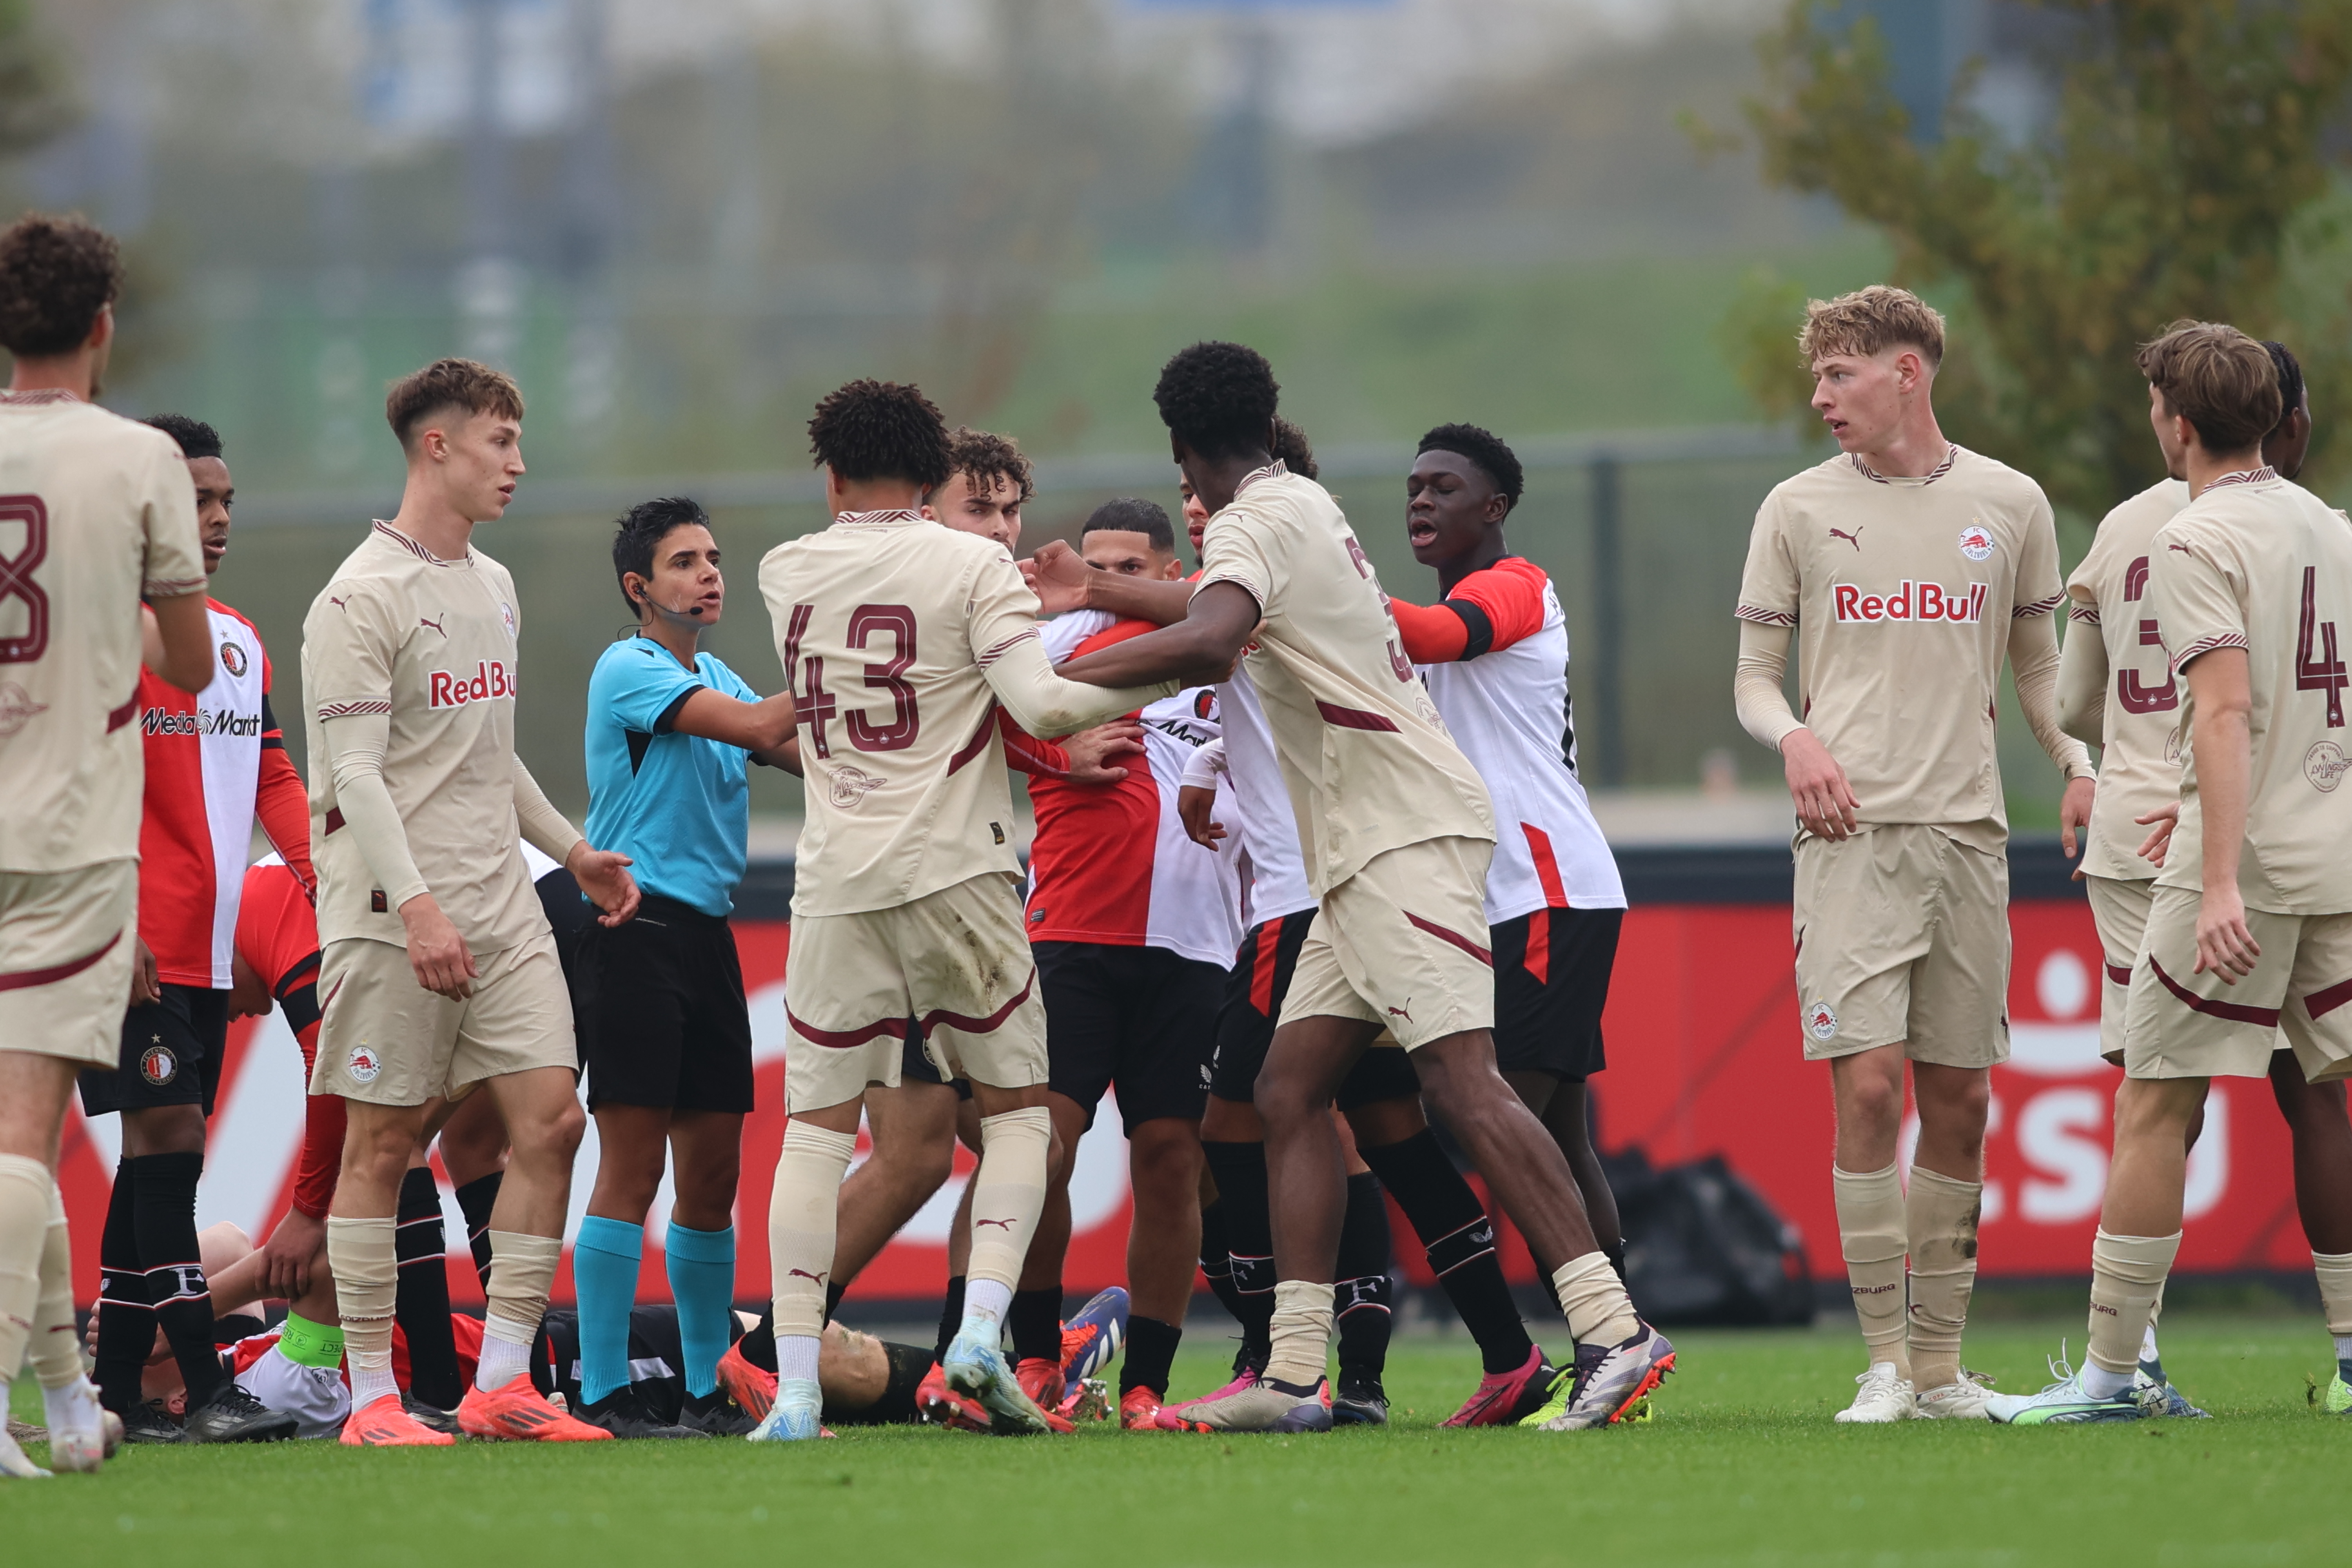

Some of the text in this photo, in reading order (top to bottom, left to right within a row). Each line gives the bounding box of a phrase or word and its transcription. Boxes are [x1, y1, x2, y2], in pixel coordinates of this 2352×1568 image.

[1832, 579, 1989, 623] Red Bull
[2296, 566, 2350, 728] 4
[428, 659, 518, 710] Red Bu
[785, 604, 920, 760] 43
[140, 707, 260, 736] Media Markt
[1851, 1283, 1896, 1294] ZBURG
[1929, 1392, 1945, 1402] COPA
